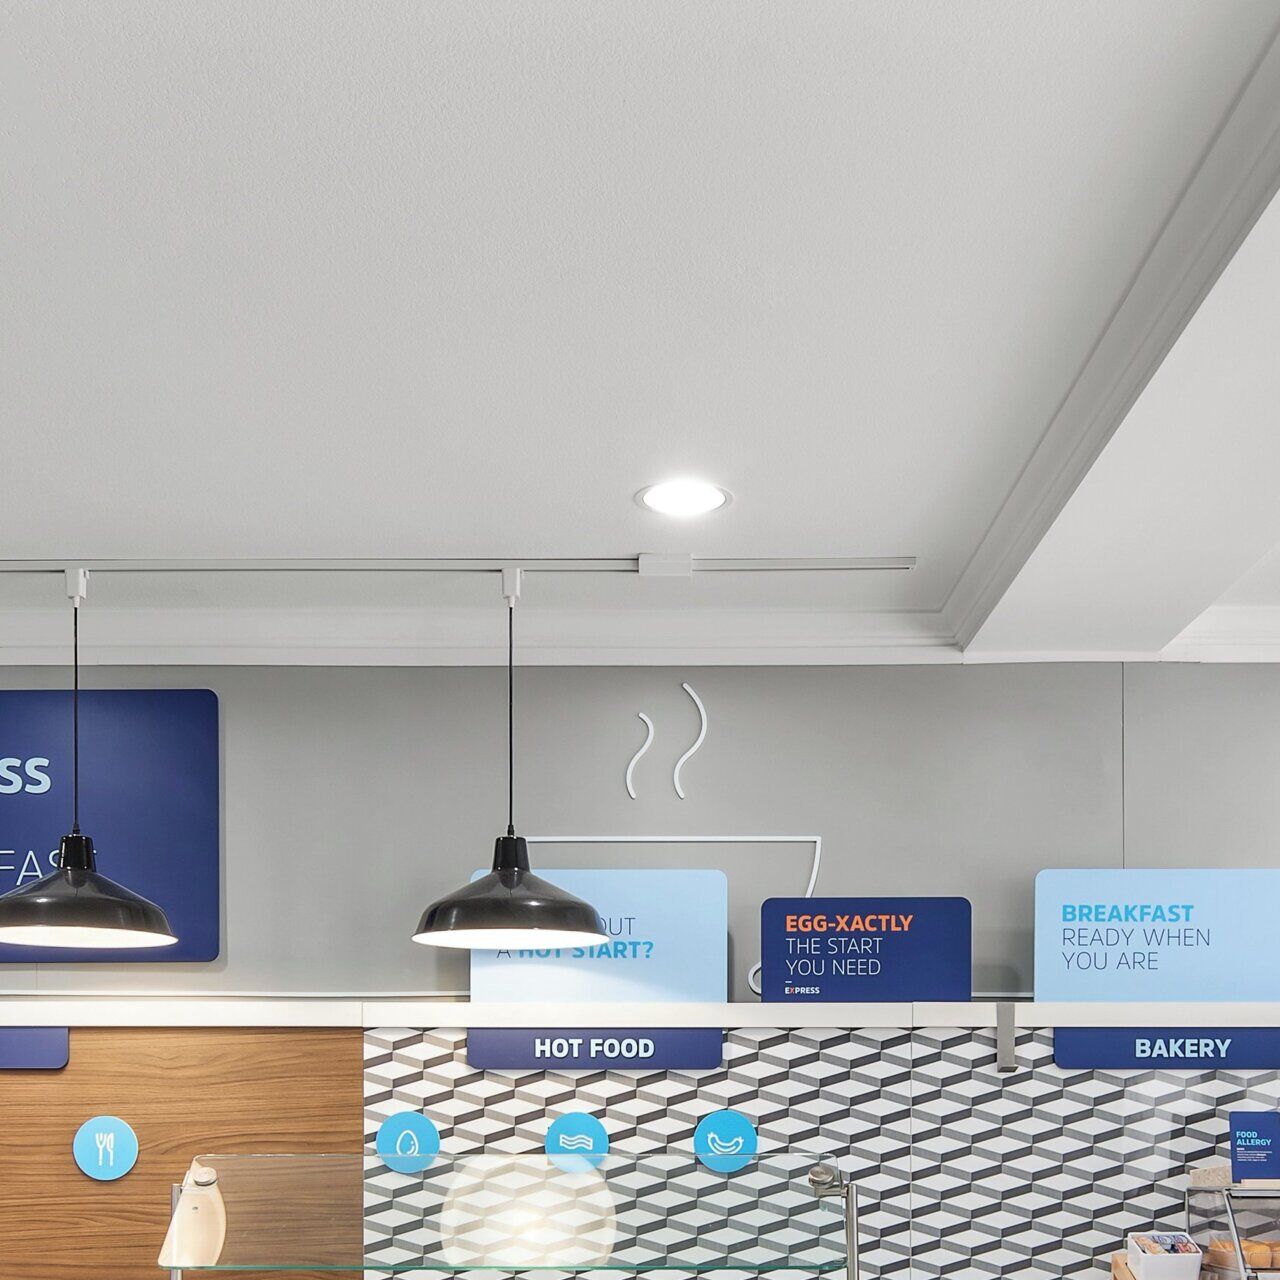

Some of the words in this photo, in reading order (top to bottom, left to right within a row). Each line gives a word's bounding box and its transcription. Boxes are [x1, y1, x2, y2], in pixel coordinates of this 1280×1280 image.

[1062, 904, 1194, 923] BREAKFAST
[600, 917, 636, 936] UT
[785, 914, 913, 932] EGG-XACTLY
[785, 938, 821, 955] THE
[827, 937, 882, 955] START
[1062, 929, 1137, 948] READY
[1144, 928, 1211, 948] WHEN
[572, 941, 654, 959] START?
[785, 959, 825, 977] YOU
[832, 959, 881, 976] NEED
[1062, 952, 1110, 971] YOU
[1116, 952, 1159, 971] ARE
[785, 986, 820, 995] EXPRESS
[534, 1038, 583, 1059] HOT
[589, 1038, 655, 1060] FOOD
[1135, 1038, 1231, 1058] BAKERY
[1236, 1131, 1257, 1139] FOOD
